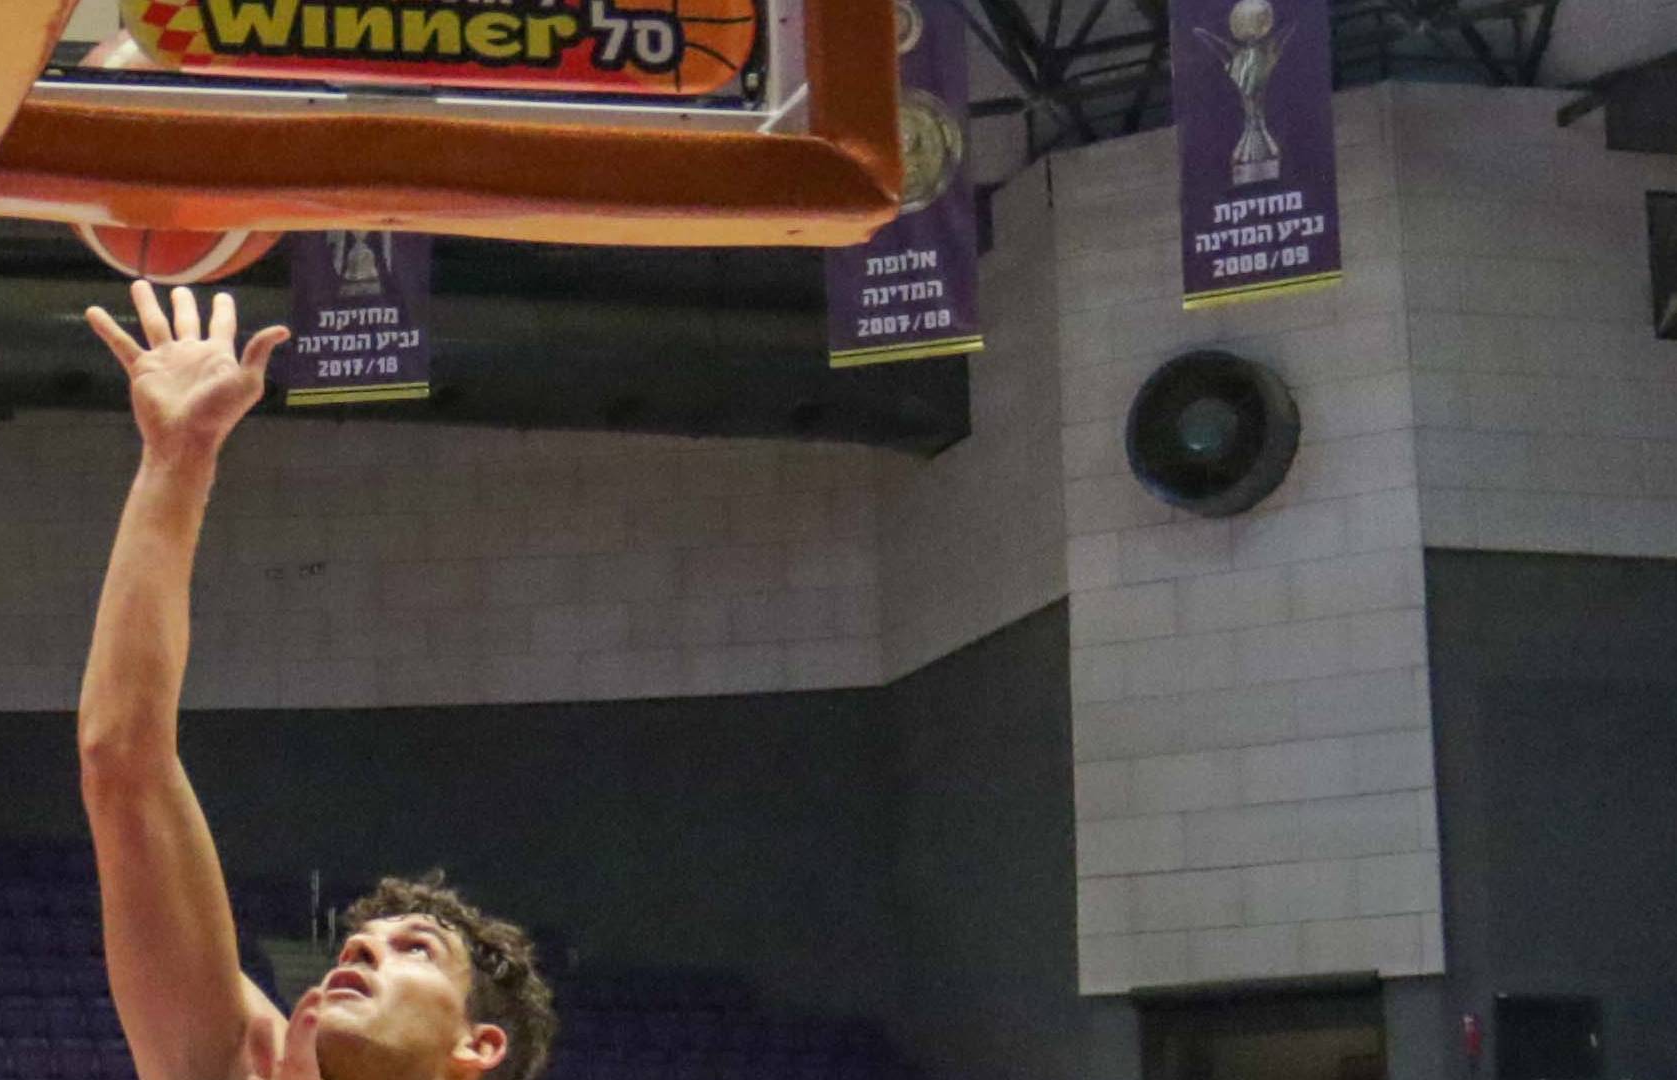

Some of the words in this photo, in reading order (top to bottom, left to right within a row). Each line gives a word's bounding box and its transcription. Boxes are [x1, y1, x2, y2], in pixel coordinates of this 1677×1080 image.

[207, 0, 578, 59] Winner
[1214, 191, 1302, 224] מחזיקת
[1195, 224, 1272, 253] המדינה
[866, 250, 937, 276] אלופת
[1213, 246, 1309, 277] 2008/09
[862, 280, 943, 307] המדינה
[318, 307, 398, 331] מחזיקת
[857, 309, 951, 337] 2007/08
[298, 333, 371, 354] המדינה
[317, 356, 398, 377] 2017/18
